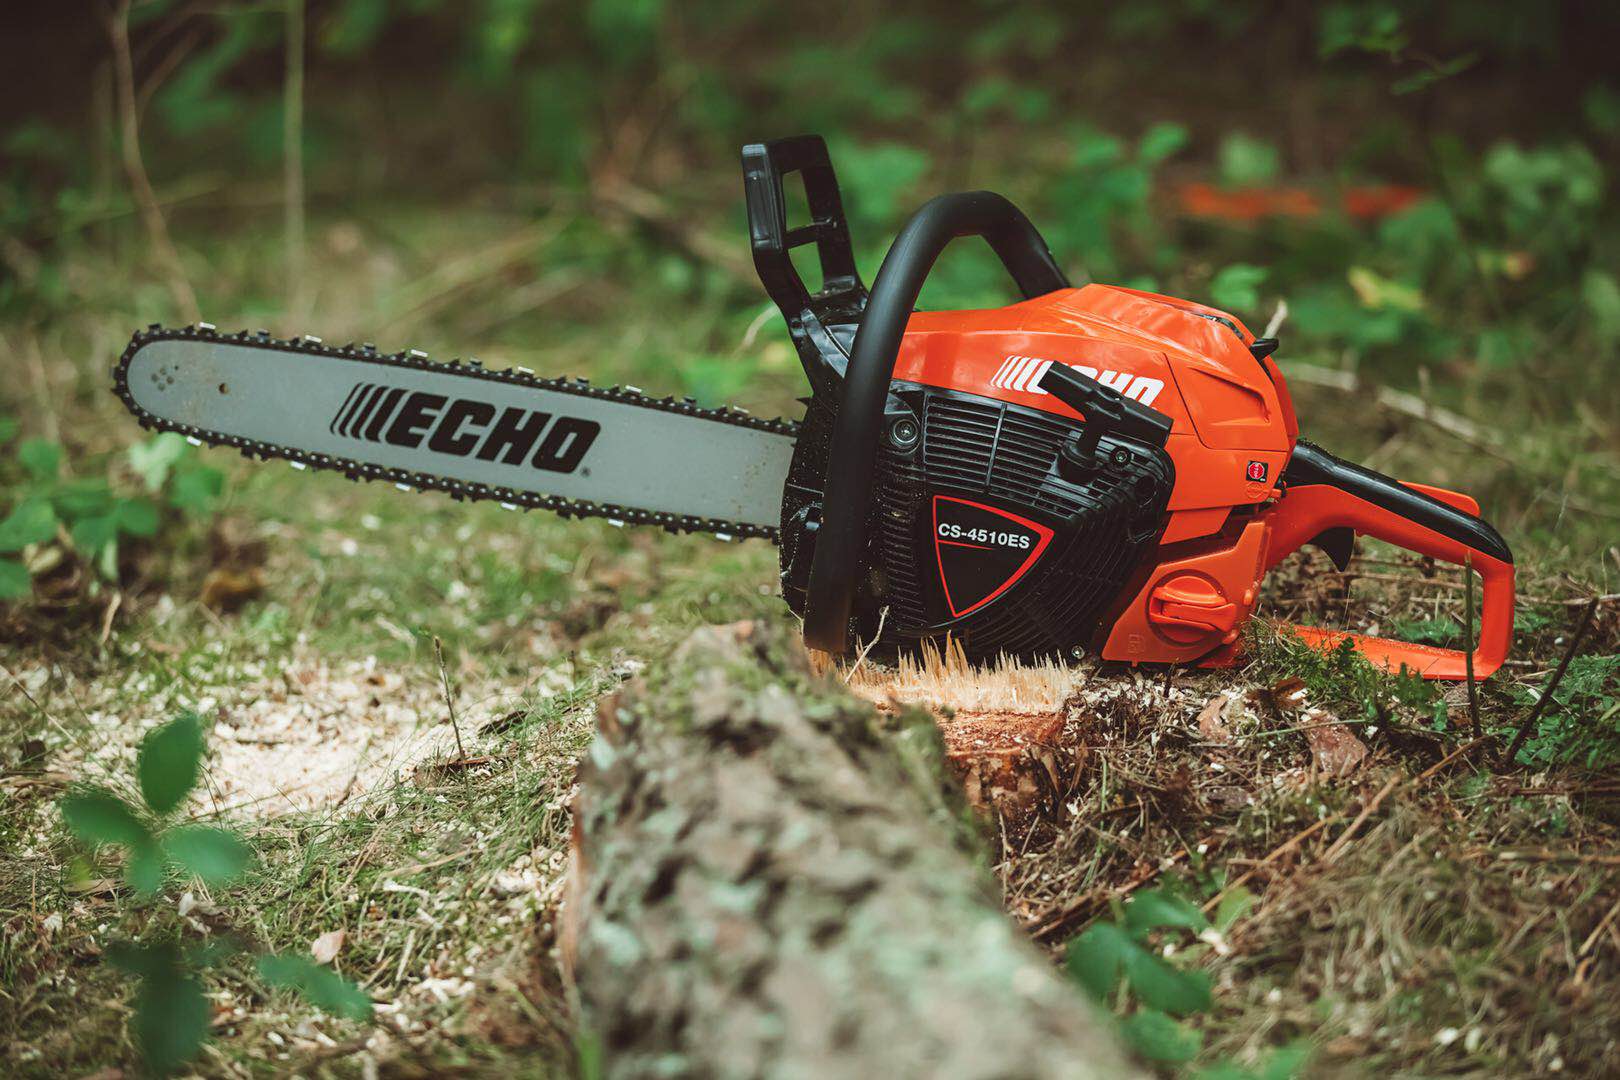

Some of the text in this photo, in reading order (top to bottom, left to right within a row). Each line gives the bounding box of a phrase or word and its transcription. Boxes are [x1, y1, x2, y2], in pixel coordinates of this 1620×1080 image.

[1026, 360, 1165, 407] EHO
[384, 391, 600, 474] ECHO
[938, 523, 1031, 549] CS-4510ES
